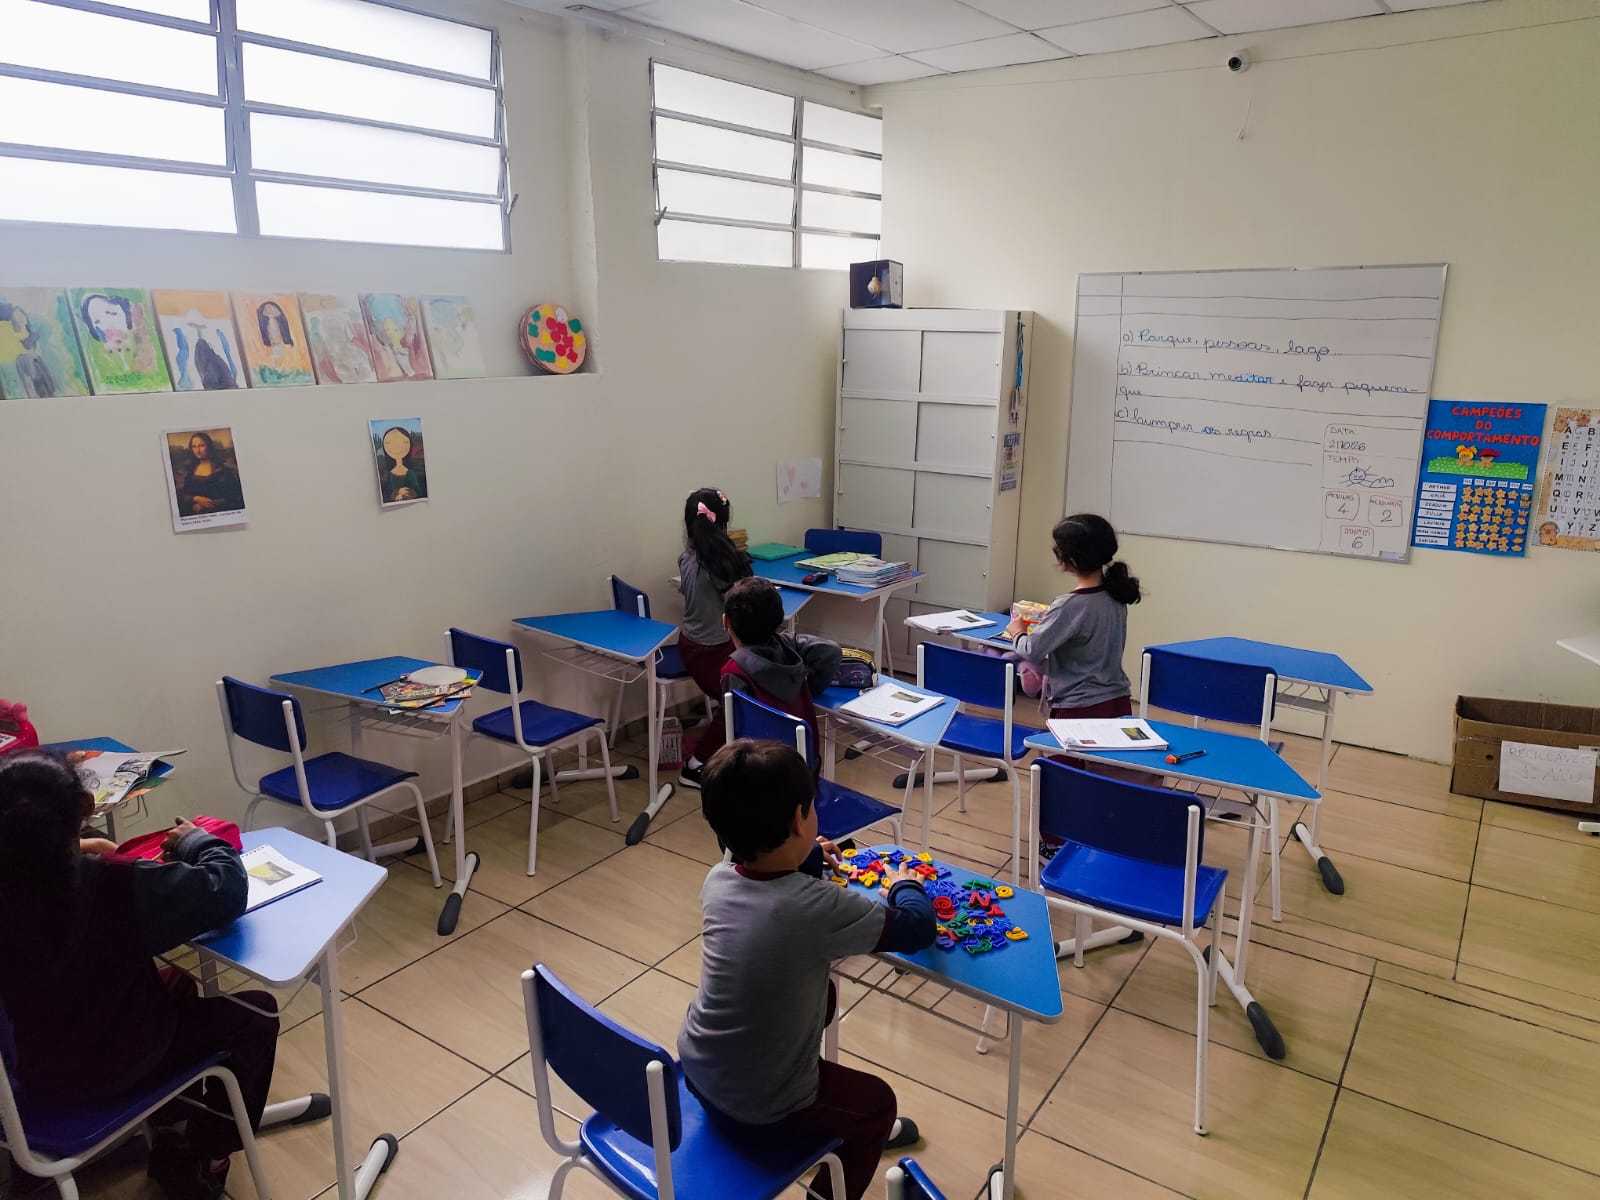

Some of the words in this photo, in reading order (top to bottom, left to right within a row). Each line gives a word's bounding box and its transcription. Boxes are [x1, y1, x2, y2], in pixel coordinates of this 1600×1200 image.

[1451, 405, 1522, 419] CAMPEÕES
[1330, 426, 1355, 436] DATA
[1475, 420, 1492, 431] DO
[1564, 426, 1572, 434] A
[1587, 427, 1596, 436] B
[1426, 430, 1540, 446] COMPORTAMENTO
[1561, 441, 1569, 450] E
[1585, 443, 1592, 452] F
[1554, 473, 1564, 481] M
[1578, 475, 1587, 483] N
[1552, 489, 1561, 498] Q
[1576, 491, 1584, 499] R
[1337, 502, 1350, 515] 4
[1550, 505, 1558, 513] U
[1573, 507, 1581, 515] V
[1380, 509, 1393, 522] 2
[1567, 522, 1574, 530] Y
[1588, 523, 1597, 532] Z
[1351, 536, 1364, 549] 6
